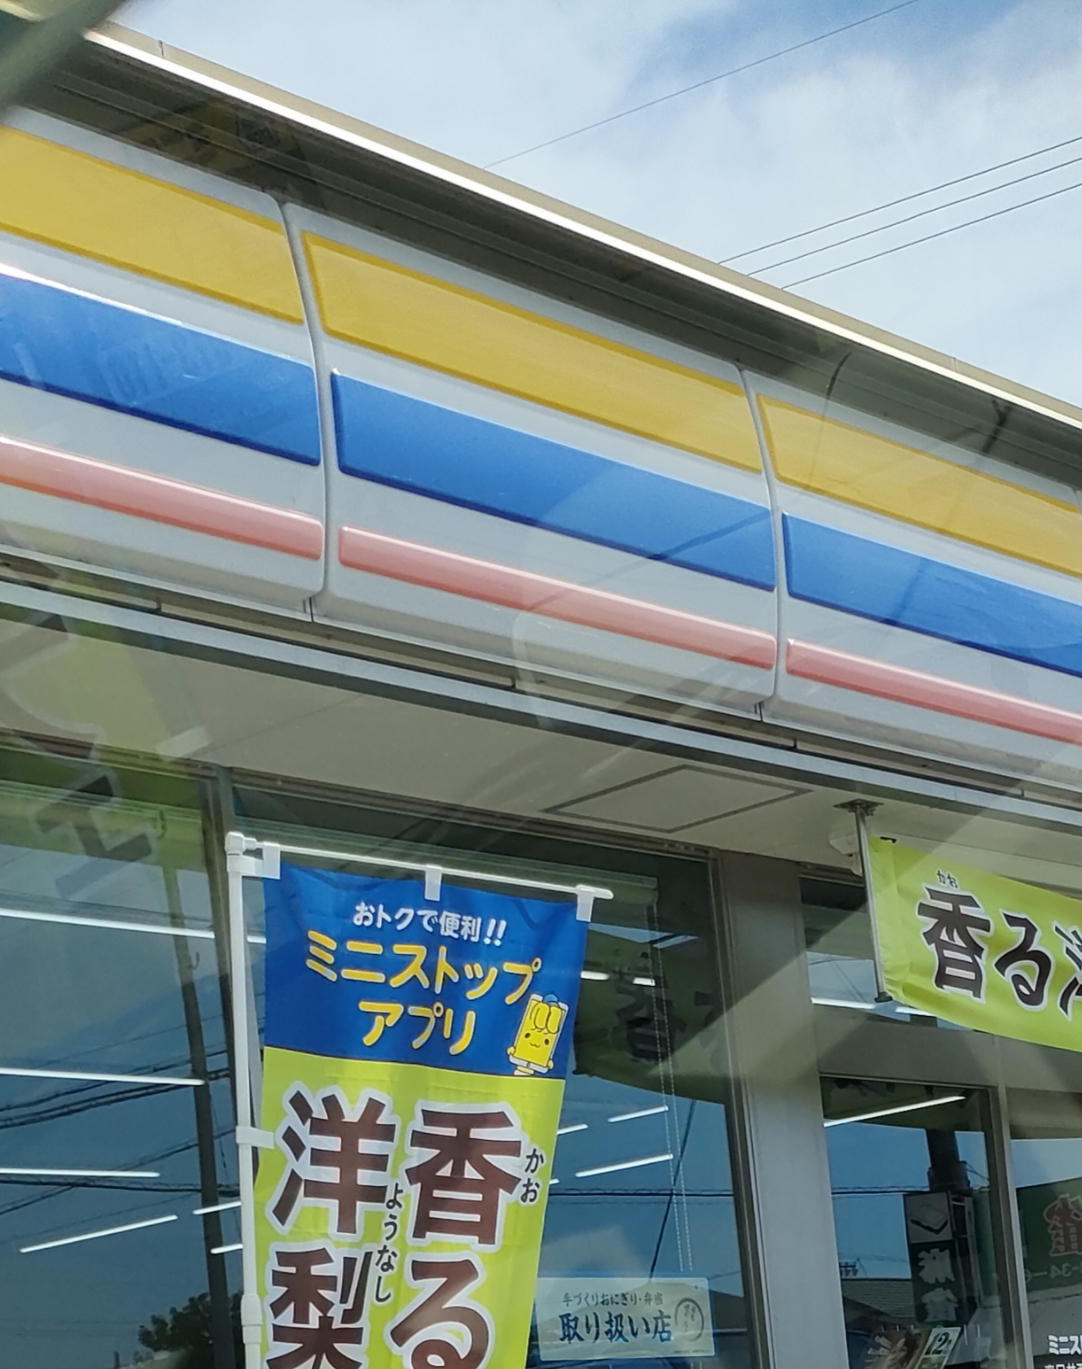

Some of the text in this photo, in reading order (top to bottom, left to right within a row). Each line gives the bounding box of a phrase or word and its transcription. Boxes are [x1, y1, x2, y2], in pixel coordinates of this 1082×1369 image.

[306, 930, 542, 1005] ミニストップ
[358, 1000, 476, 1056] アプリ
[520, 1148, 545, 1204] かお
[375, 1184, 403, 1304] ようなし
[558, 1310, 674, 1344] 取り扱い店
